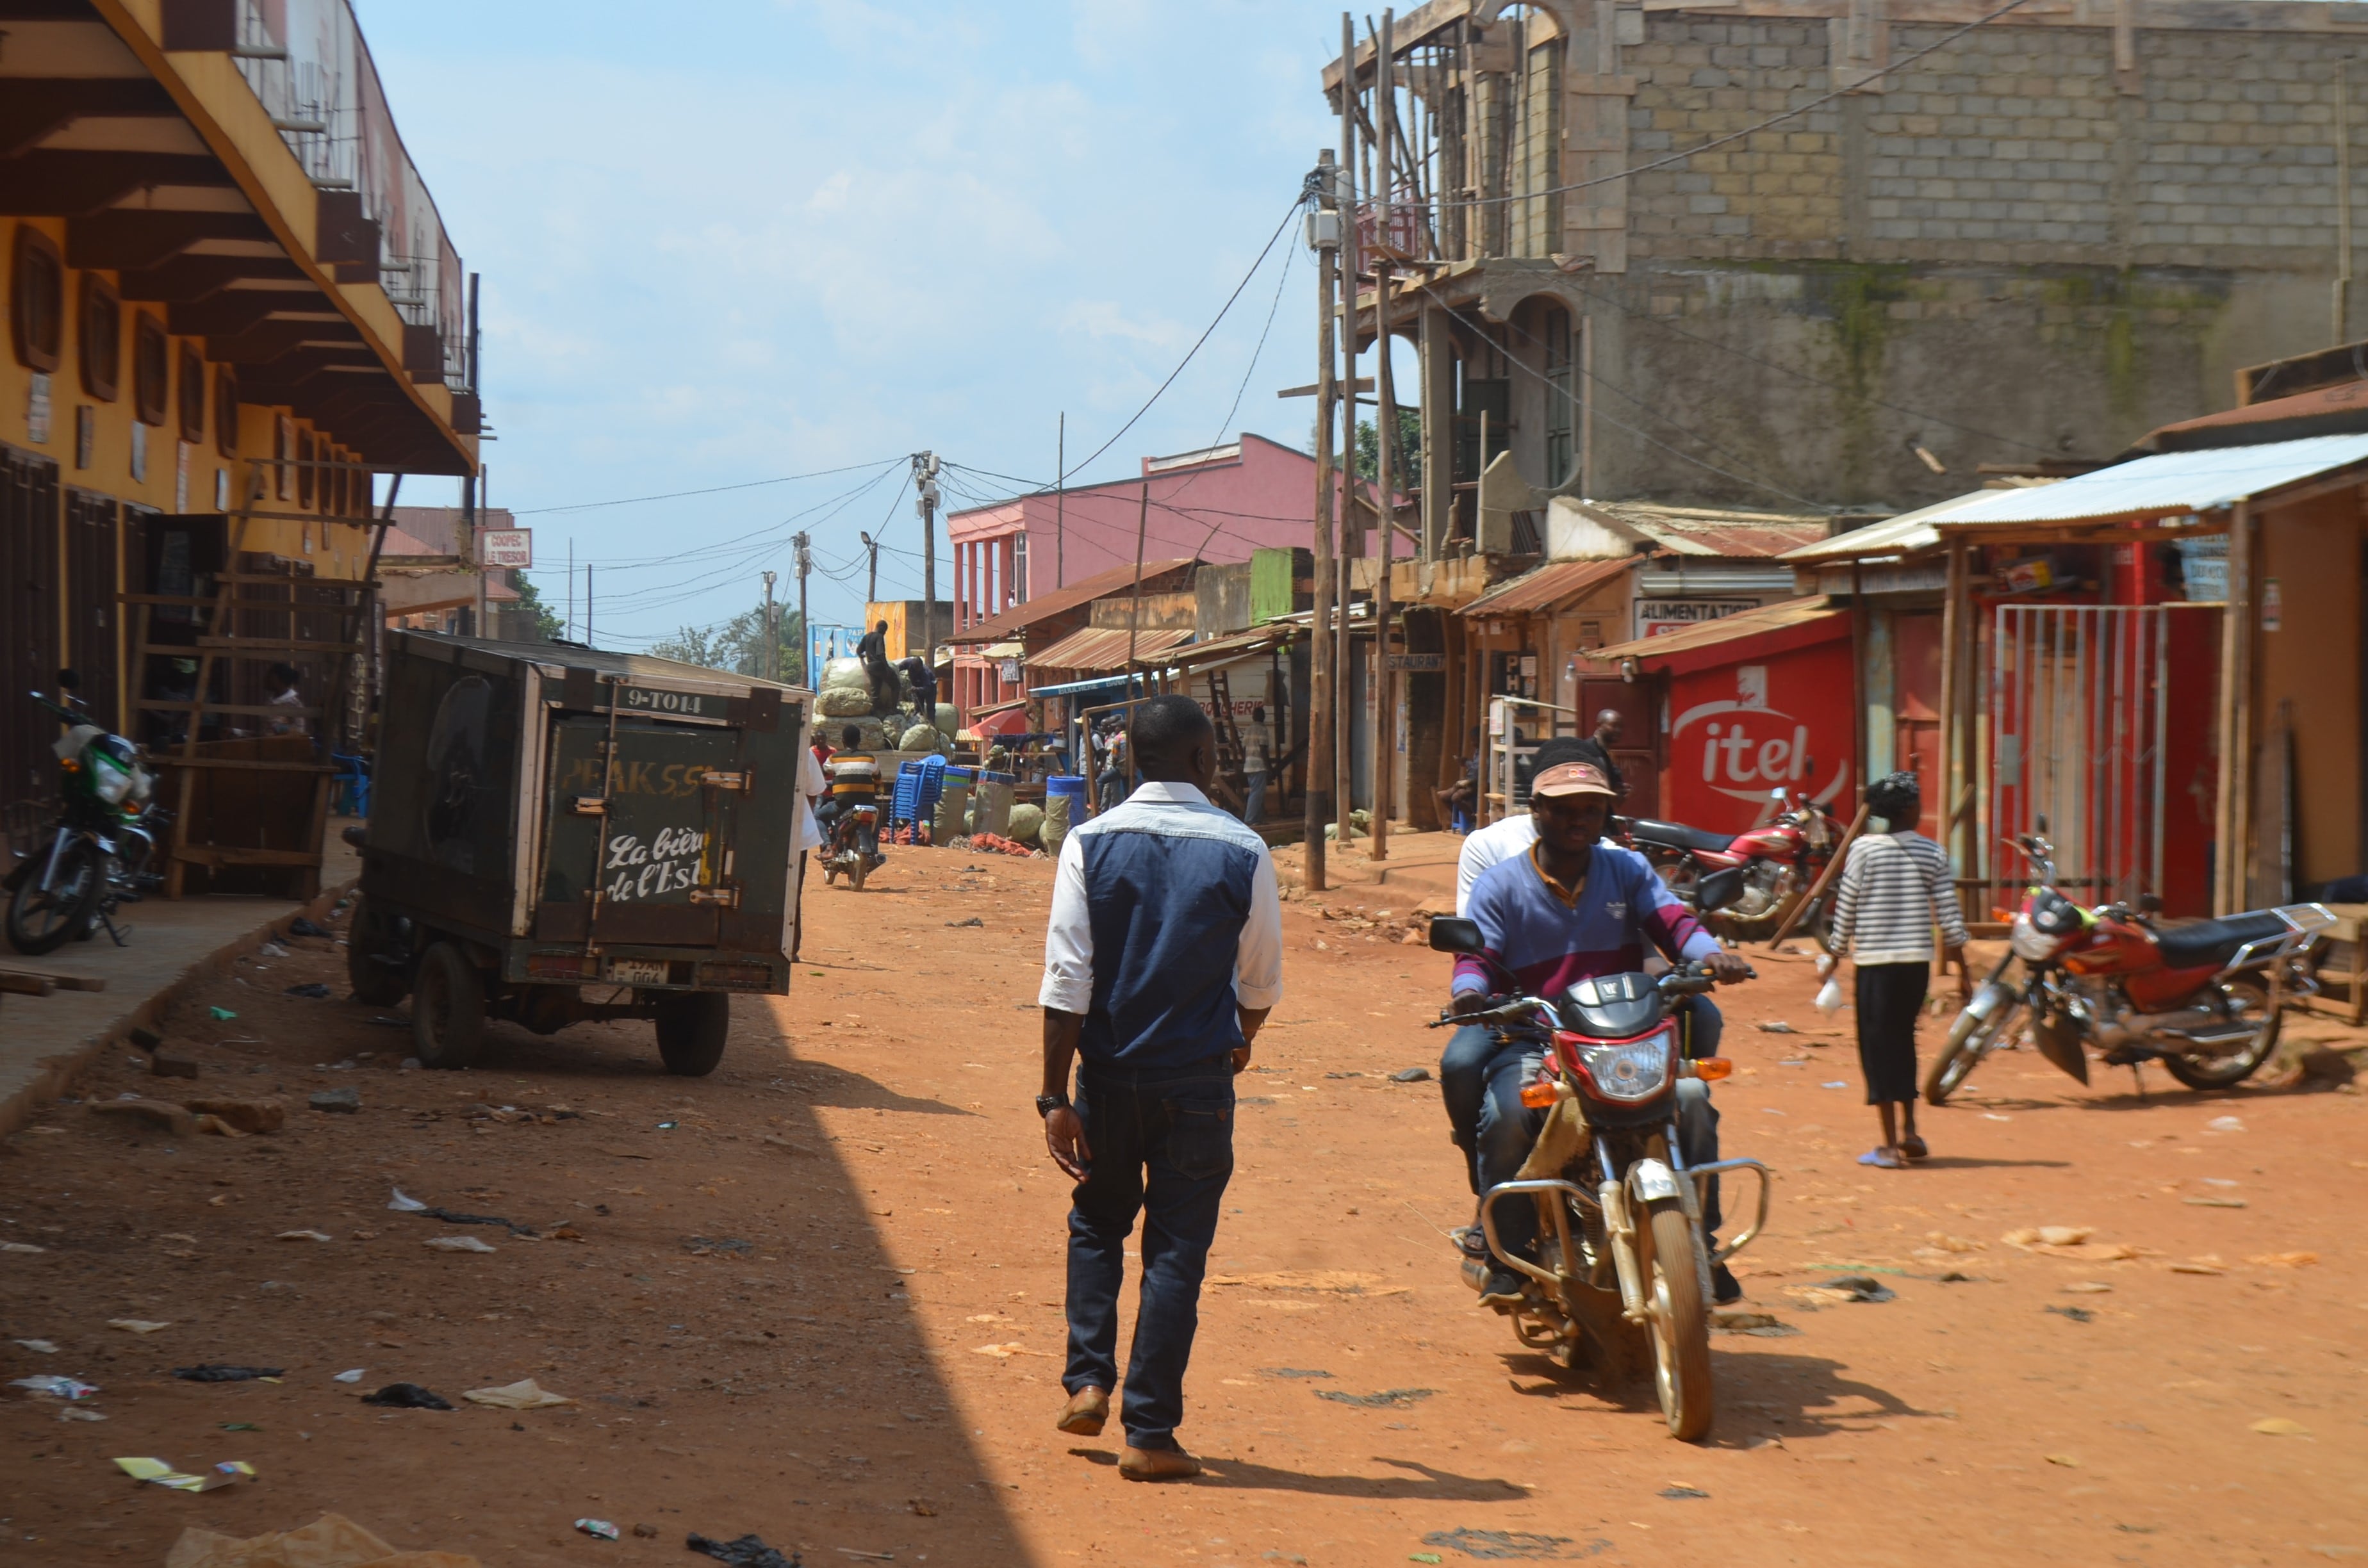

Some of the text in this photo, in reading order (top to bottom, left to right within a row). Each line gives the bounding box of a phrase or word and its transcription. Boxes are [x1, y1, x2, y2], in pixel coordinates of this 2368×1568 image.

[487, 550, 527, 564] LE TRESOR
[1388, 655, 1446, 667] STAURANT
[1702, 723, 1809, 782] itel
[606, 827, 704, 869] La bièr
